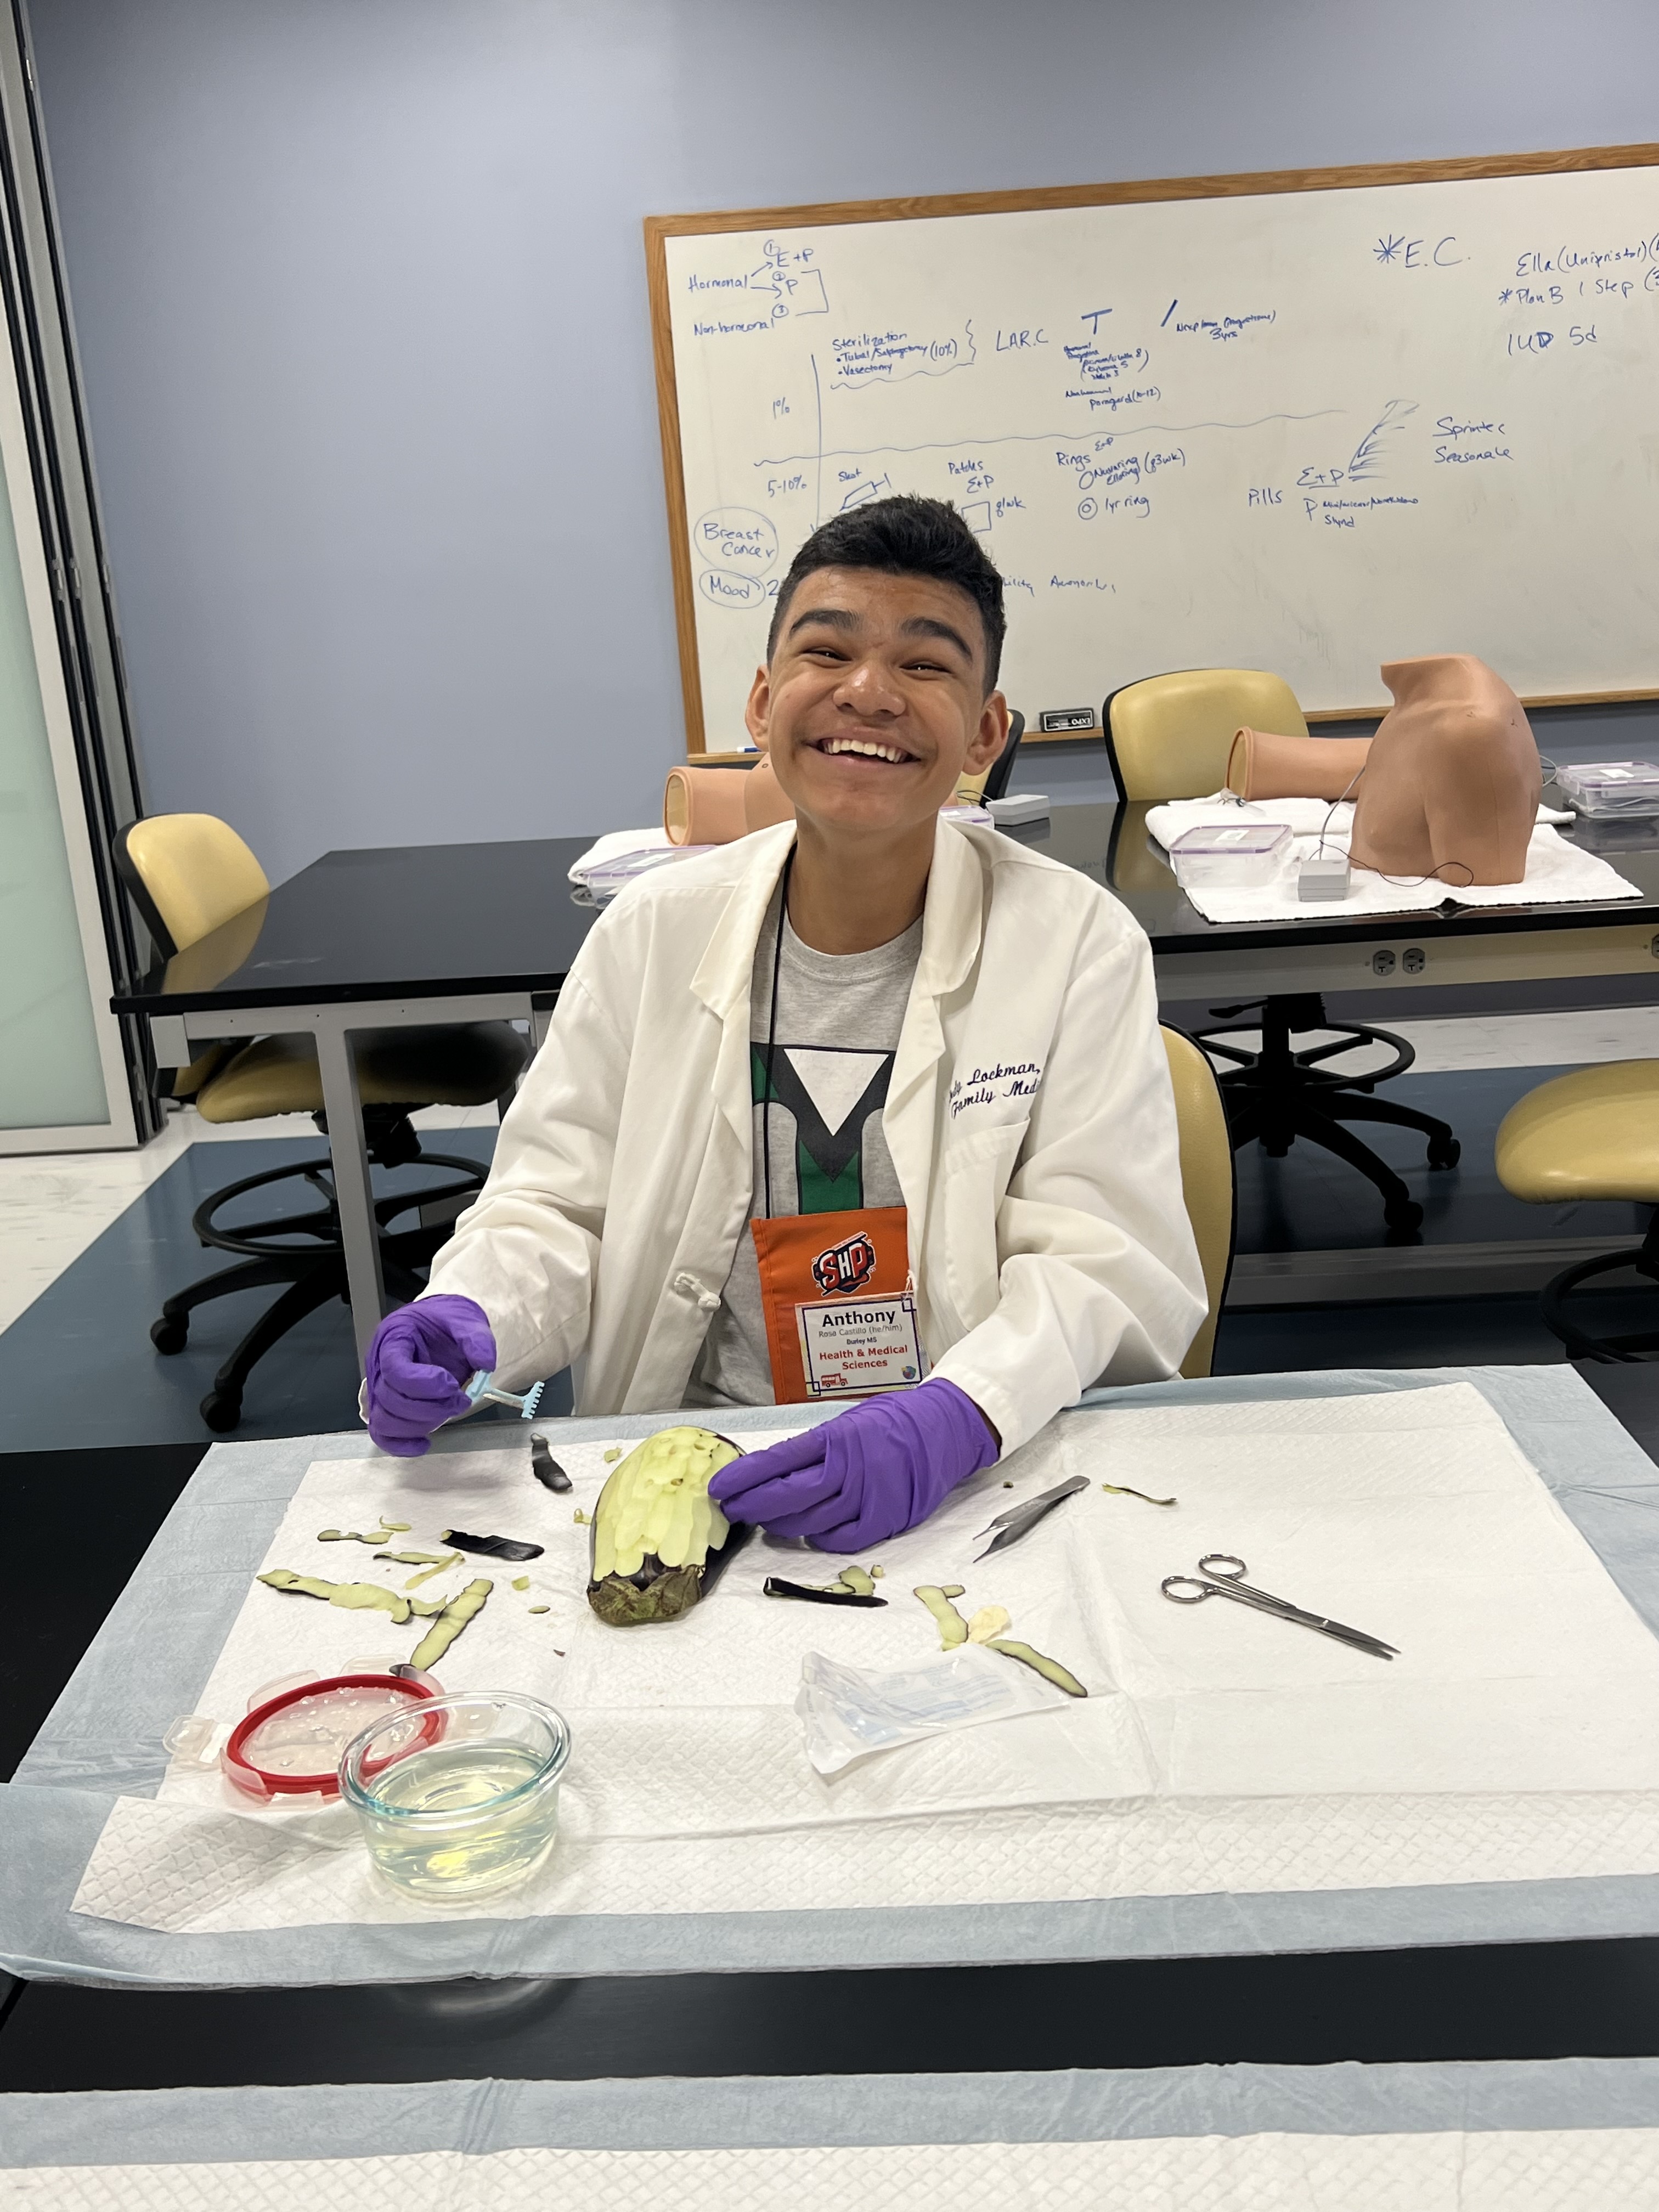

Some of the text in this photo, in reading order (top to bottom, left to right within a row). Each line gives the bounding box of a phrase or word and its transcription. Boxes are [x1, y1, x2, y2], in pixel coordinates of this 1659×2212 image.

[689, 274, 747, 293] Hormonal
[1549, 286, 1564, 304] B
[832, 331, 907, 351] Sterilization
[1056, 452, 1091, 472] Rings
[1248, 487, 1283, 507] Pills
[704, 523, 764, 541] Breast
[721, 541, 775, 558] Cancer
[710, 575, 750, 599] Mood
[967, 1063, 1040, 1086] Lockman,
[951, 1087, 996, 1120] Family
[820, 1242, 868, 1289] SHP
[822, 1310, 895, 1328] Anthony
[839, 1327, 867, 1336] Castillo
[820, 1344, 908, 1361] Health & Medical
[842, 1358, 888, 1370] Sciences
